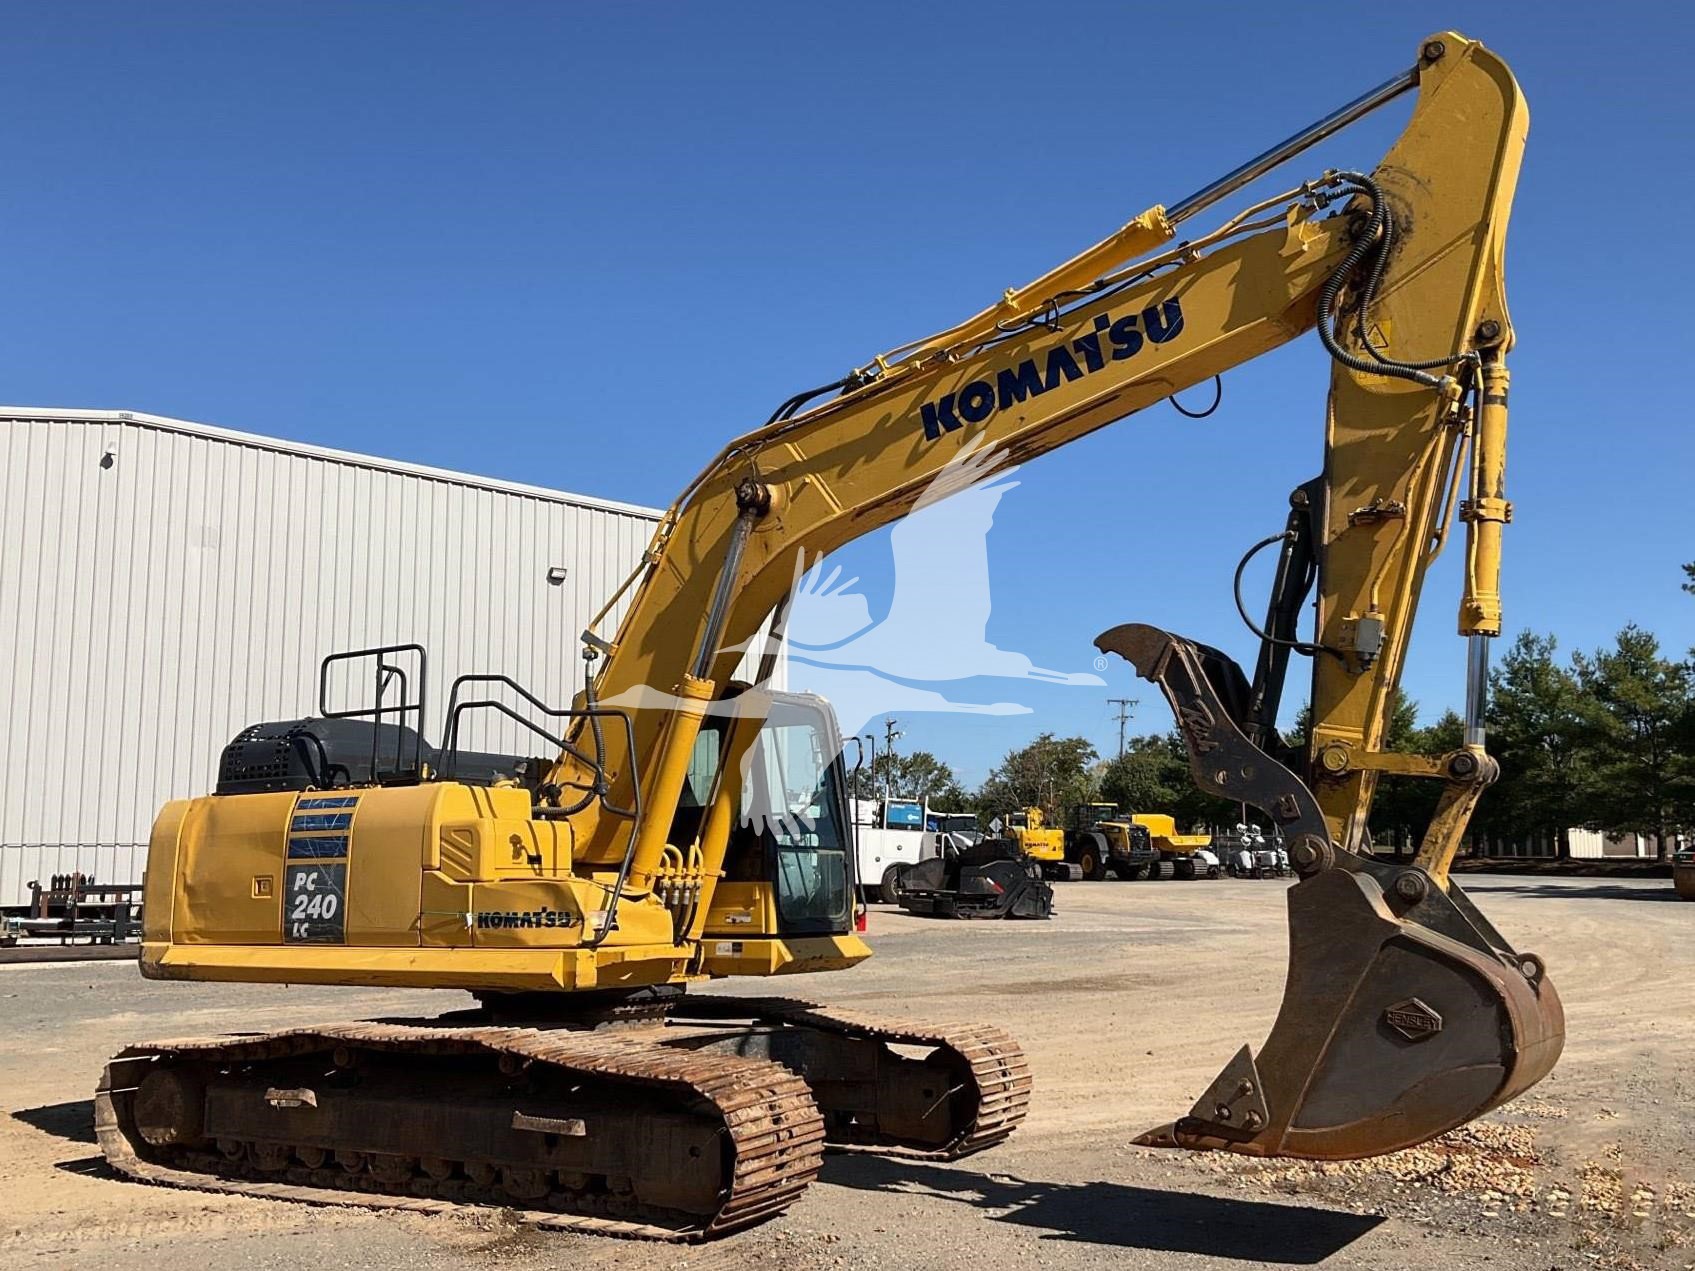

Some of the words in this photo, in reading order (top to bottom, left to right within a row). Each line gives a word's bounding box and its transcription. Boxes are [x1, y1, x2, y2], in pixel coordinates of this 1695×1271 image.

[920, 296, 1185, 441] KOMATSU
[293, 872, 318, 891] PC
[291, 894, 337, 919] 240
[477, 906, 571, 929] KOMATSU
[292, 922, 309, 938] LC
